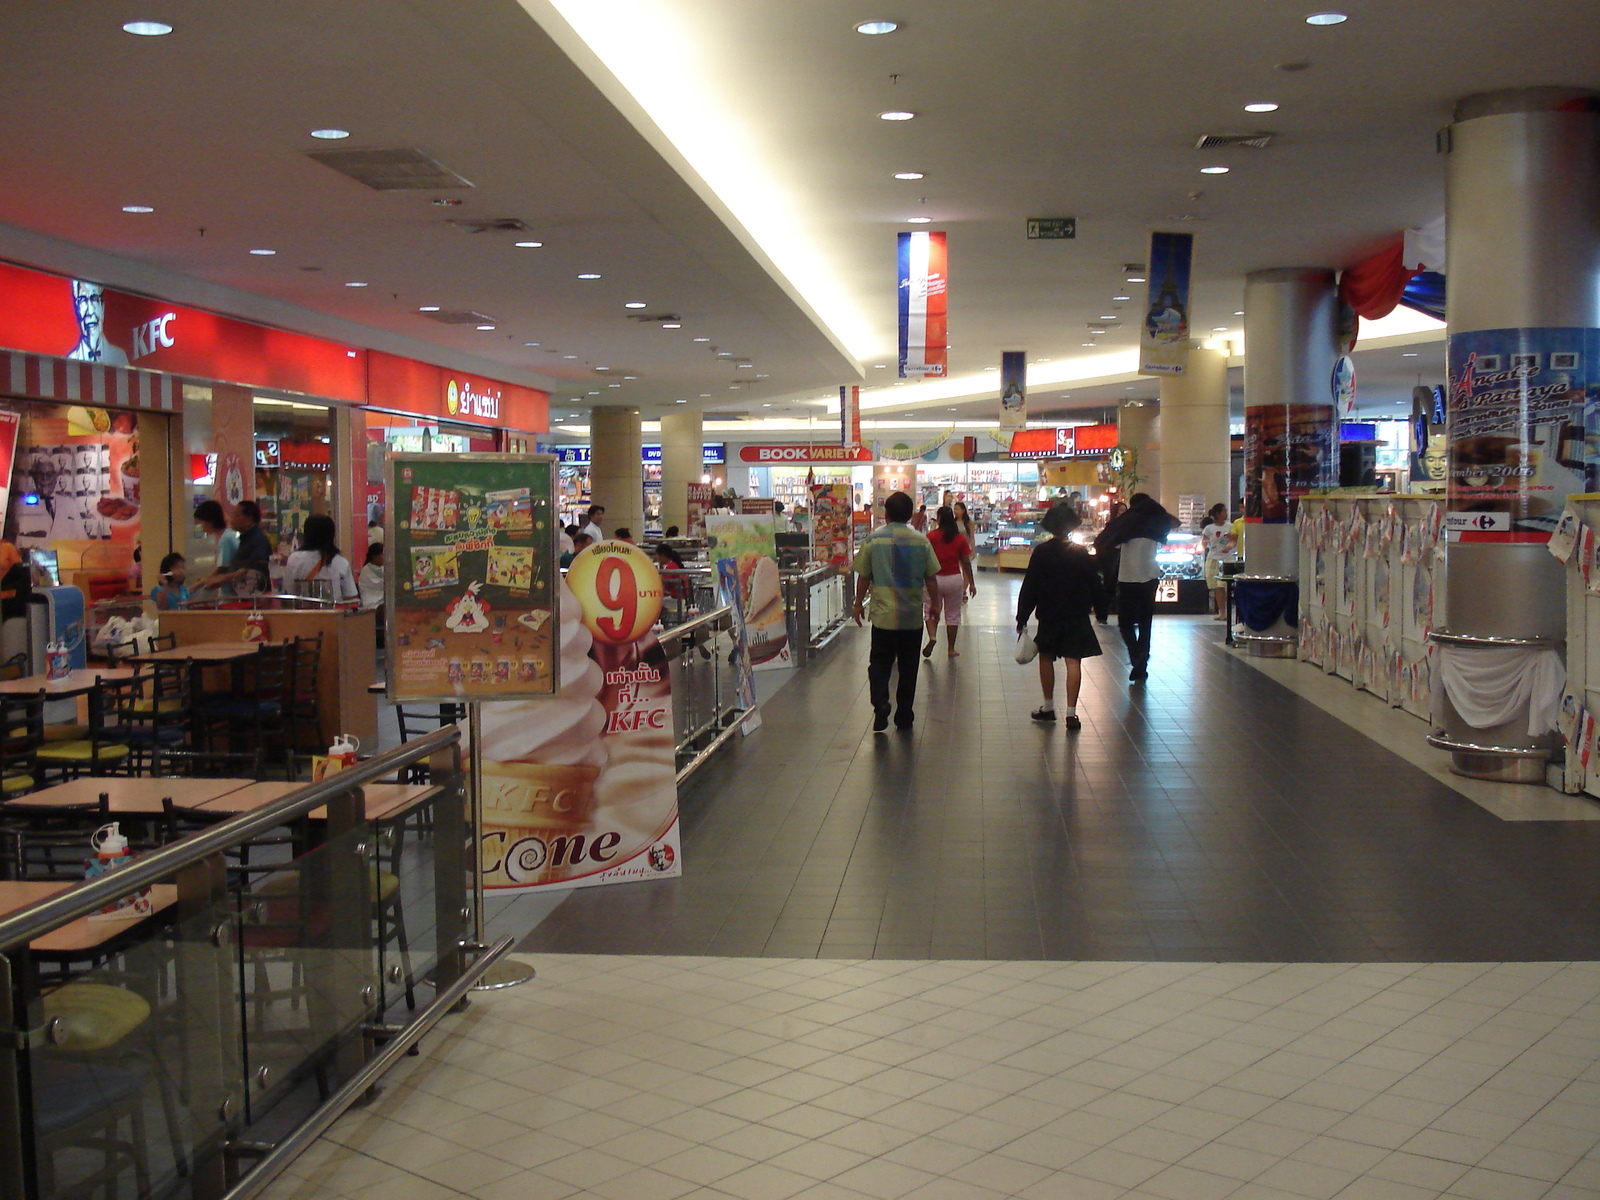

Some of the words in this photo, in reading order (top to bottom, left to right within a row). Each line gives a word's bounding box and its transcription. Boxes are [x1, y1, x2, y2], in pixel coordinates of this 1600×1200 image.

[133, 312, 175, 360] KFC
[1473, 381, 1568, 406] Pattaya
[648, 450, 662, 458] DVD
[759, 448, 808, 460] BOOK
[809, 447, 861, 460] VARIETY
[1491, 464, 1535, 478] 2006
[591, 541, 632, 556] เพียงโคนละ
[595, 556, 638, 640] 9
[606, 662, 661, 685] เท่านั้น
[608, 708, 666, 734] KFC
[486, 783, 576, 813] KFC
